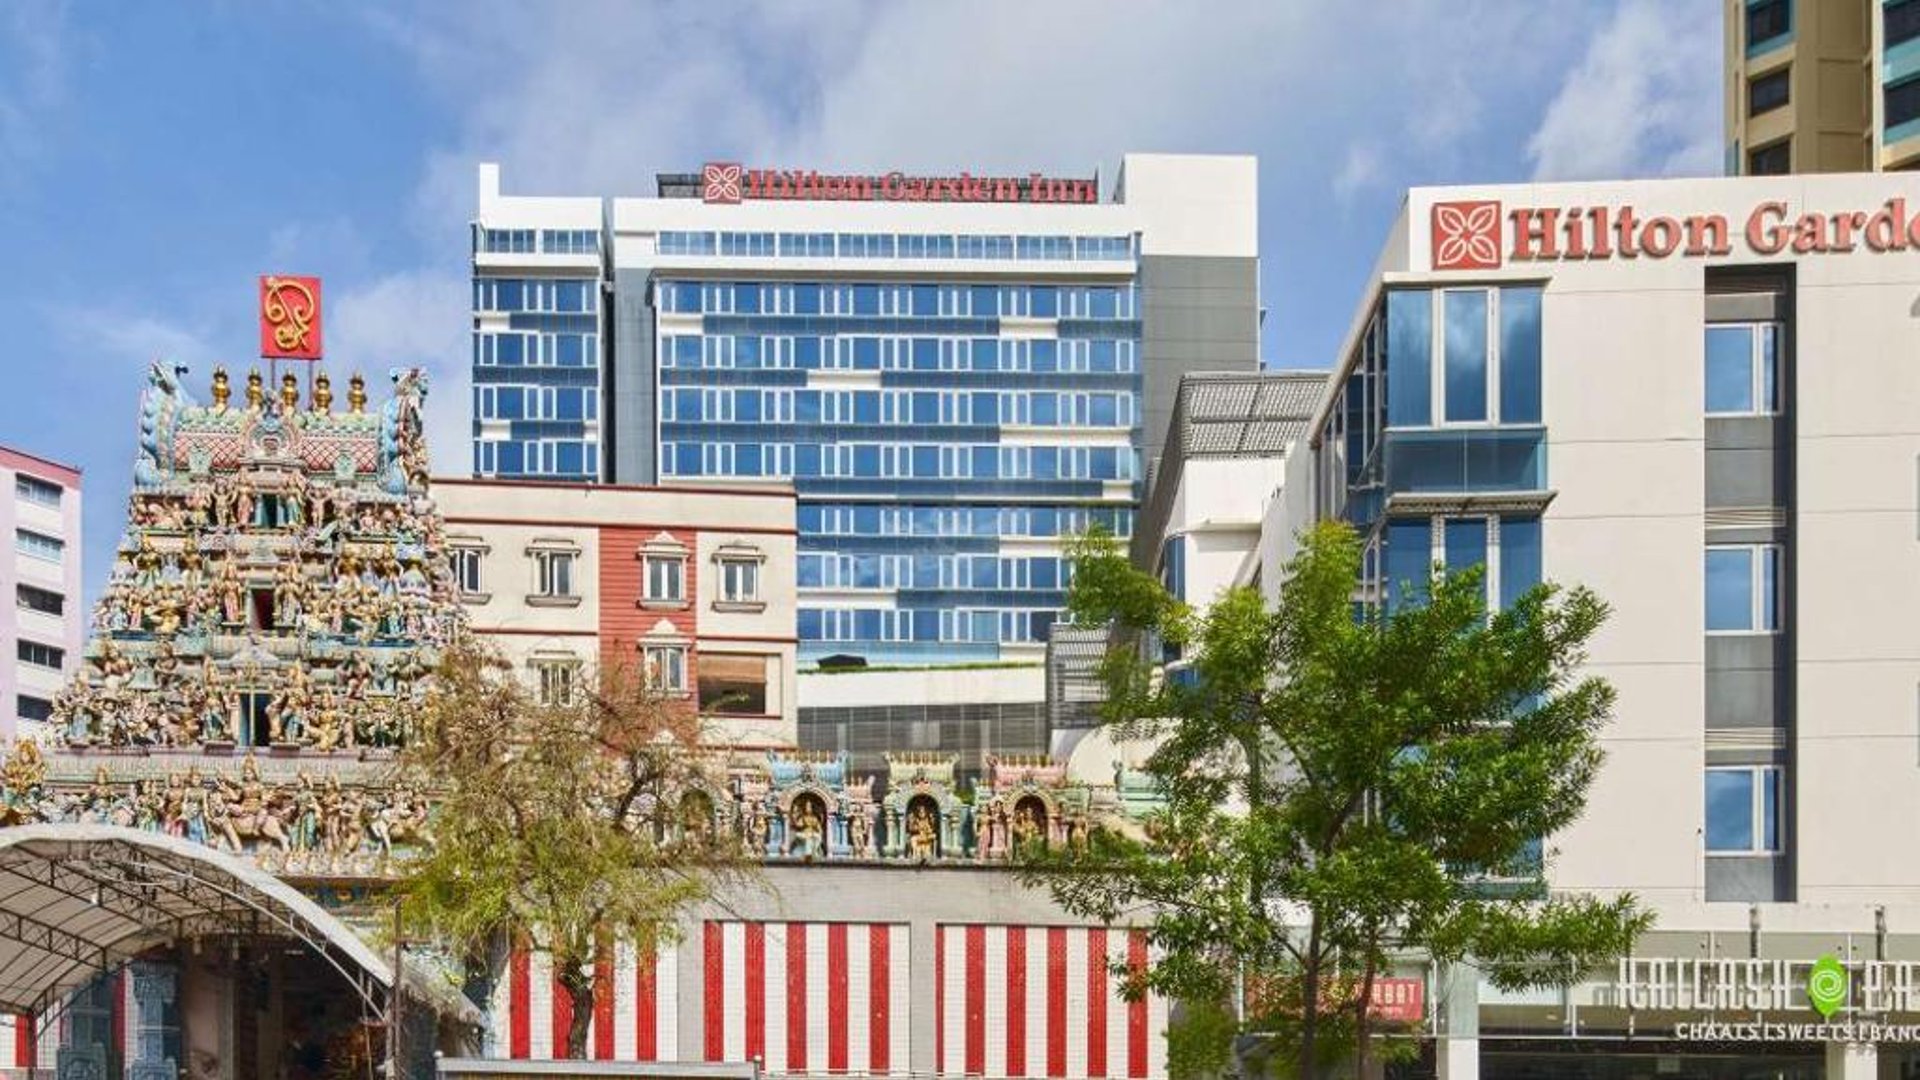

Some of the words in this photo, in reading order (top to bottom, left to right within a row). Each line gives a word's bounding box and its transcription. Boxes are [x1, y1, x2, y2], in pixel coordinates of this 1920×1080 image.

[747, 169, 873, 201] Hilton
[879, 171, 1022, 202] Garden
[1028, 172, 1097, 203] Inn
[1508, 203, 1733, 262] Hilton
[1778, 1022, 1852, 1041] SWEETS
